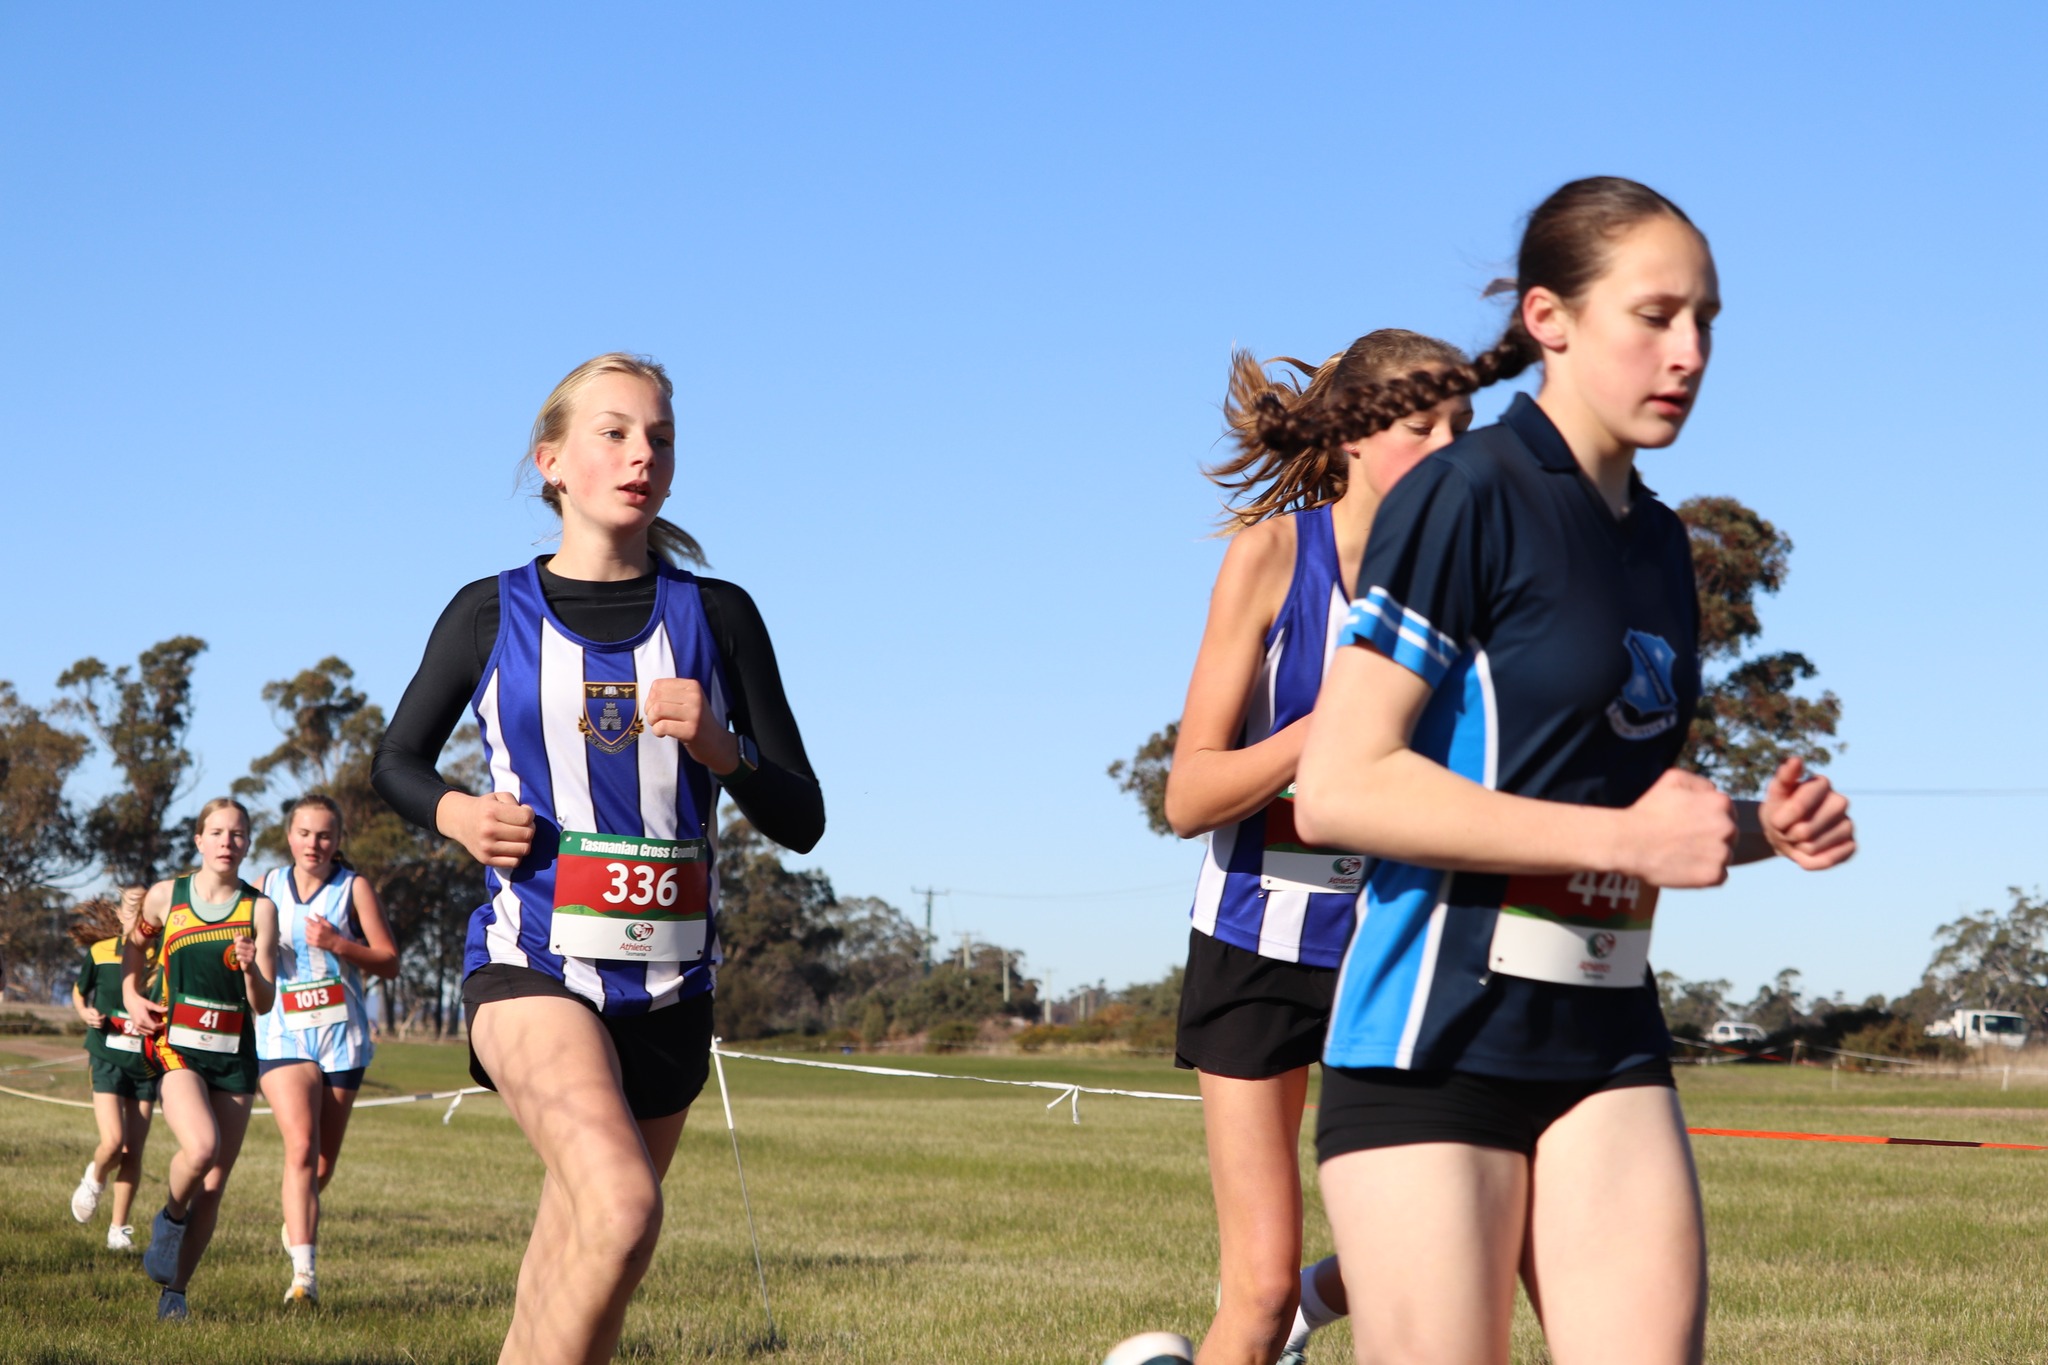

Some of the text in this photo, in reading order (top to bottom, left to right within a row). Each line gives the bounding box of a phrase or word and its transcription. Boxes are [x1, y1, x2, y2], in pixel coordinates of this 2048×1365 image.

[580, 838, 638, 856] Tasmanian
[639, 844, 670, 859] Cross
[602, 862, 679, 907] 336
[1567, 871, 1640, 911] 444
[172, 914, 187, 926] 52
[619, 942, 652, 952] Athletics
[294, 988, 330, 1009] 1013
[199, 1010, 220, 1029] 41
